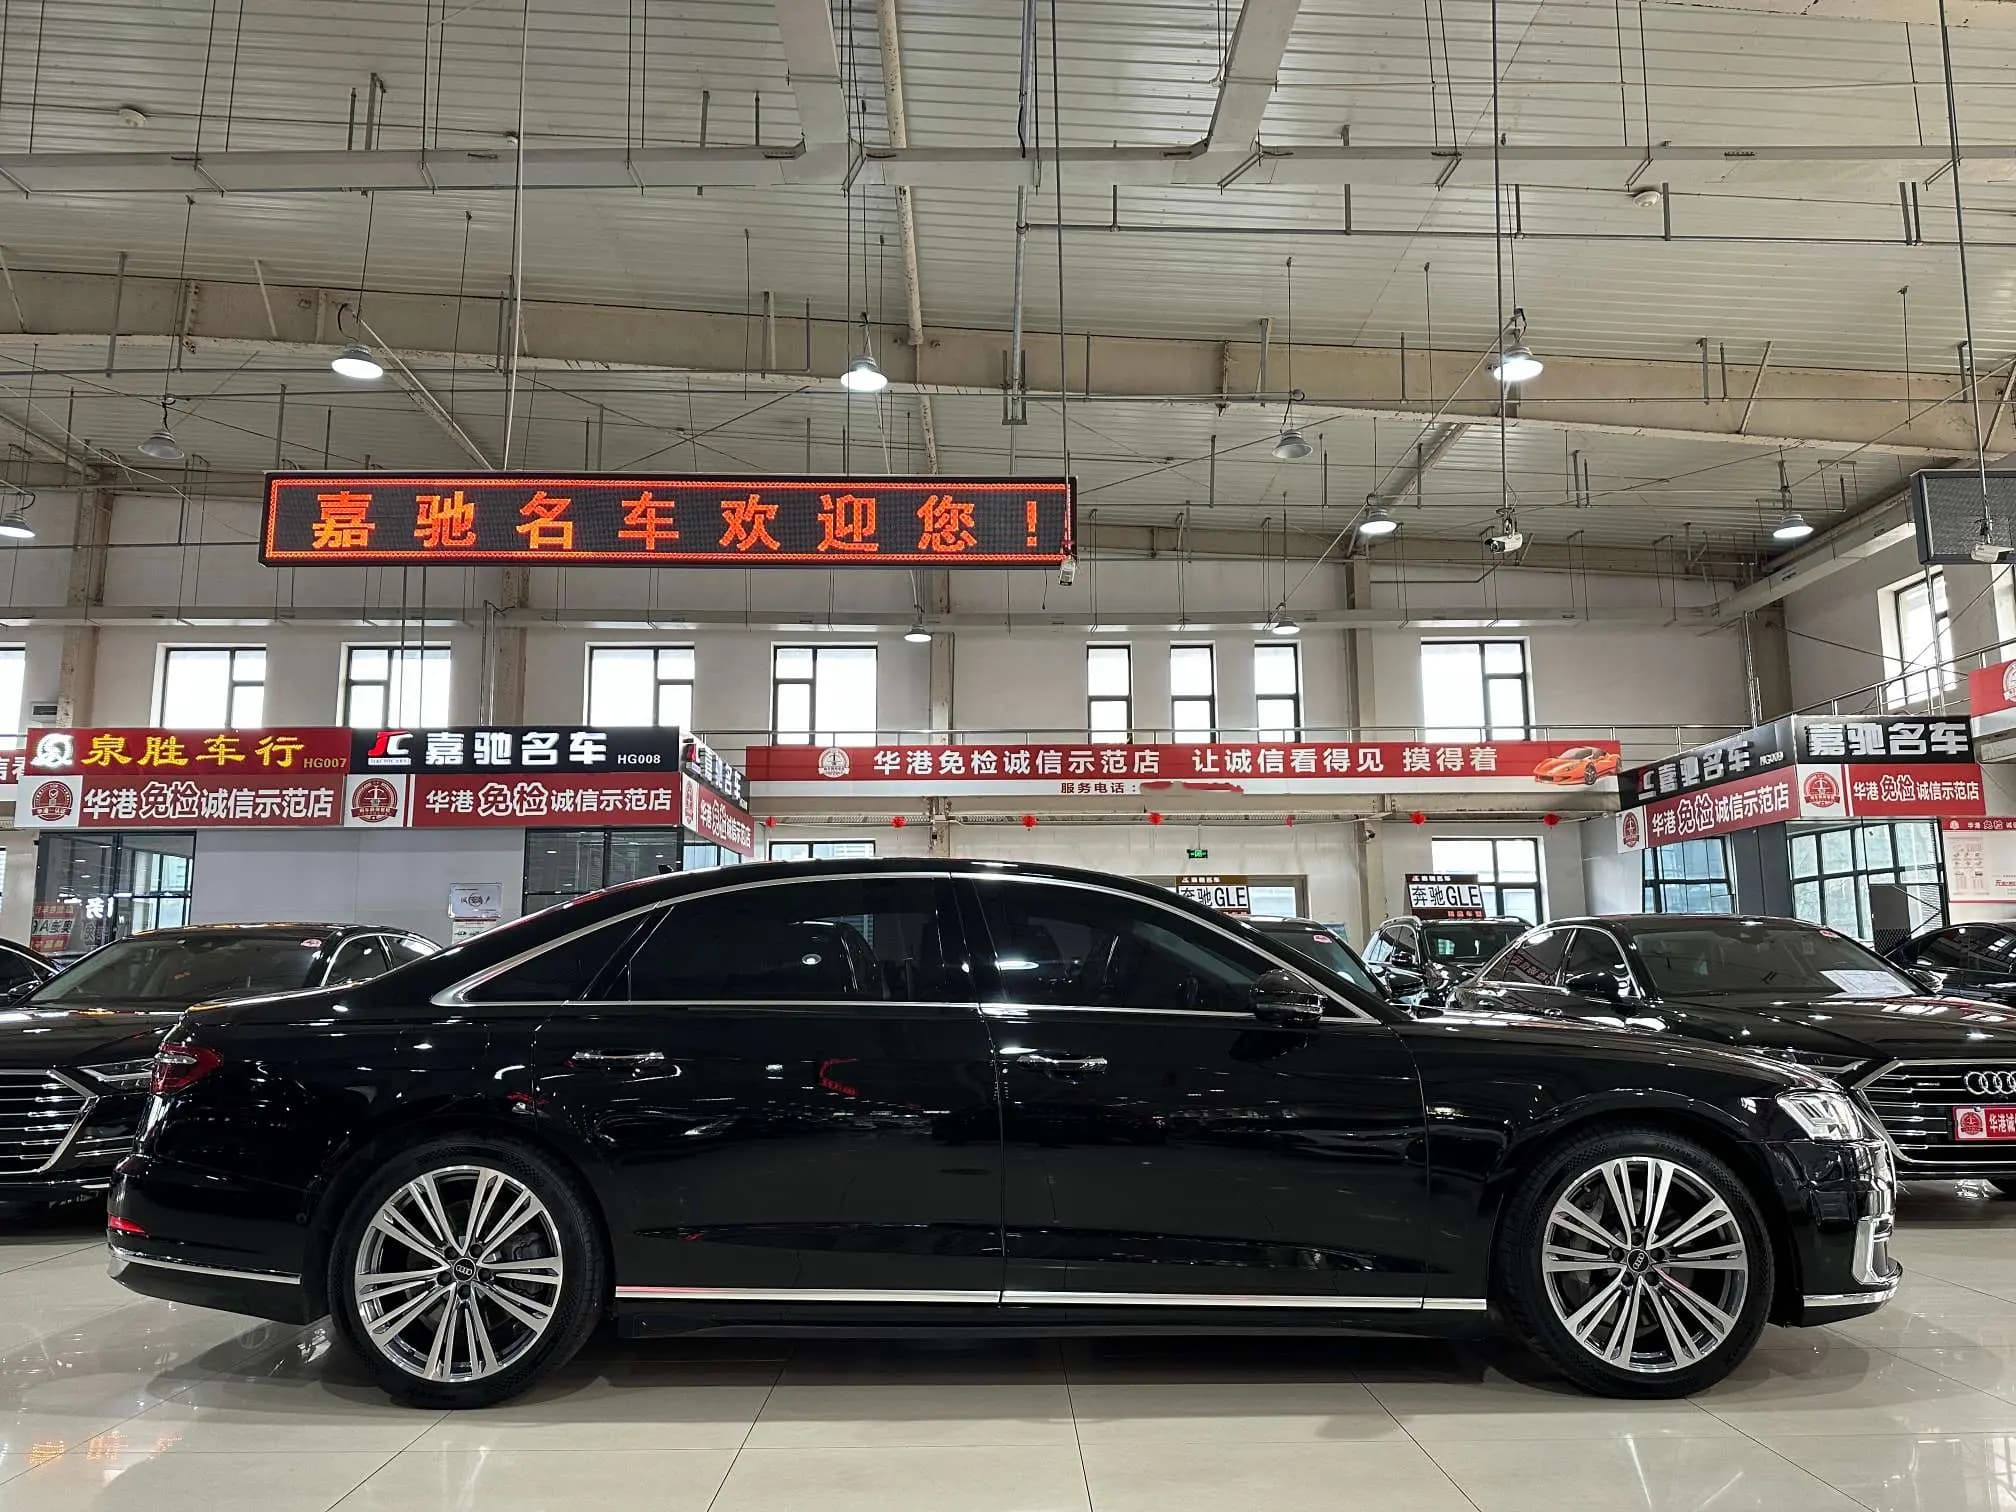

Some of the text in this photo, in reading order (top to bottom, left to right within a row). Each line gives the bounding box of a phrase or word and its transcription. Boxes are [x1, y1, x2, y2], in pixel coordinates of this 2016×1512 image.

[81, 734, 304, 767] 泉胜车行
[425, 731, 607, 766] 嘉驰名车
[1806, 723, 1969, 756] 嘉驰名车
[303, 758, 347, 769] HG007
[617, 754, 661, 765] HG008
[874, 747, 1497, 774] 华港免检诚信示范店 让诚信看得见 摸得着
[83, 781, 335, 819] 华港免检诚信示范店
[425, 782, 672, 817] 华港免检诚信示范店
[1853, 774, 1979, 802] 华港免检诚信示范店
[1652, 782, 1790, 837] 华港免检诚信示范店
[1411, 885, 1481, 907] 奔驰GLE
